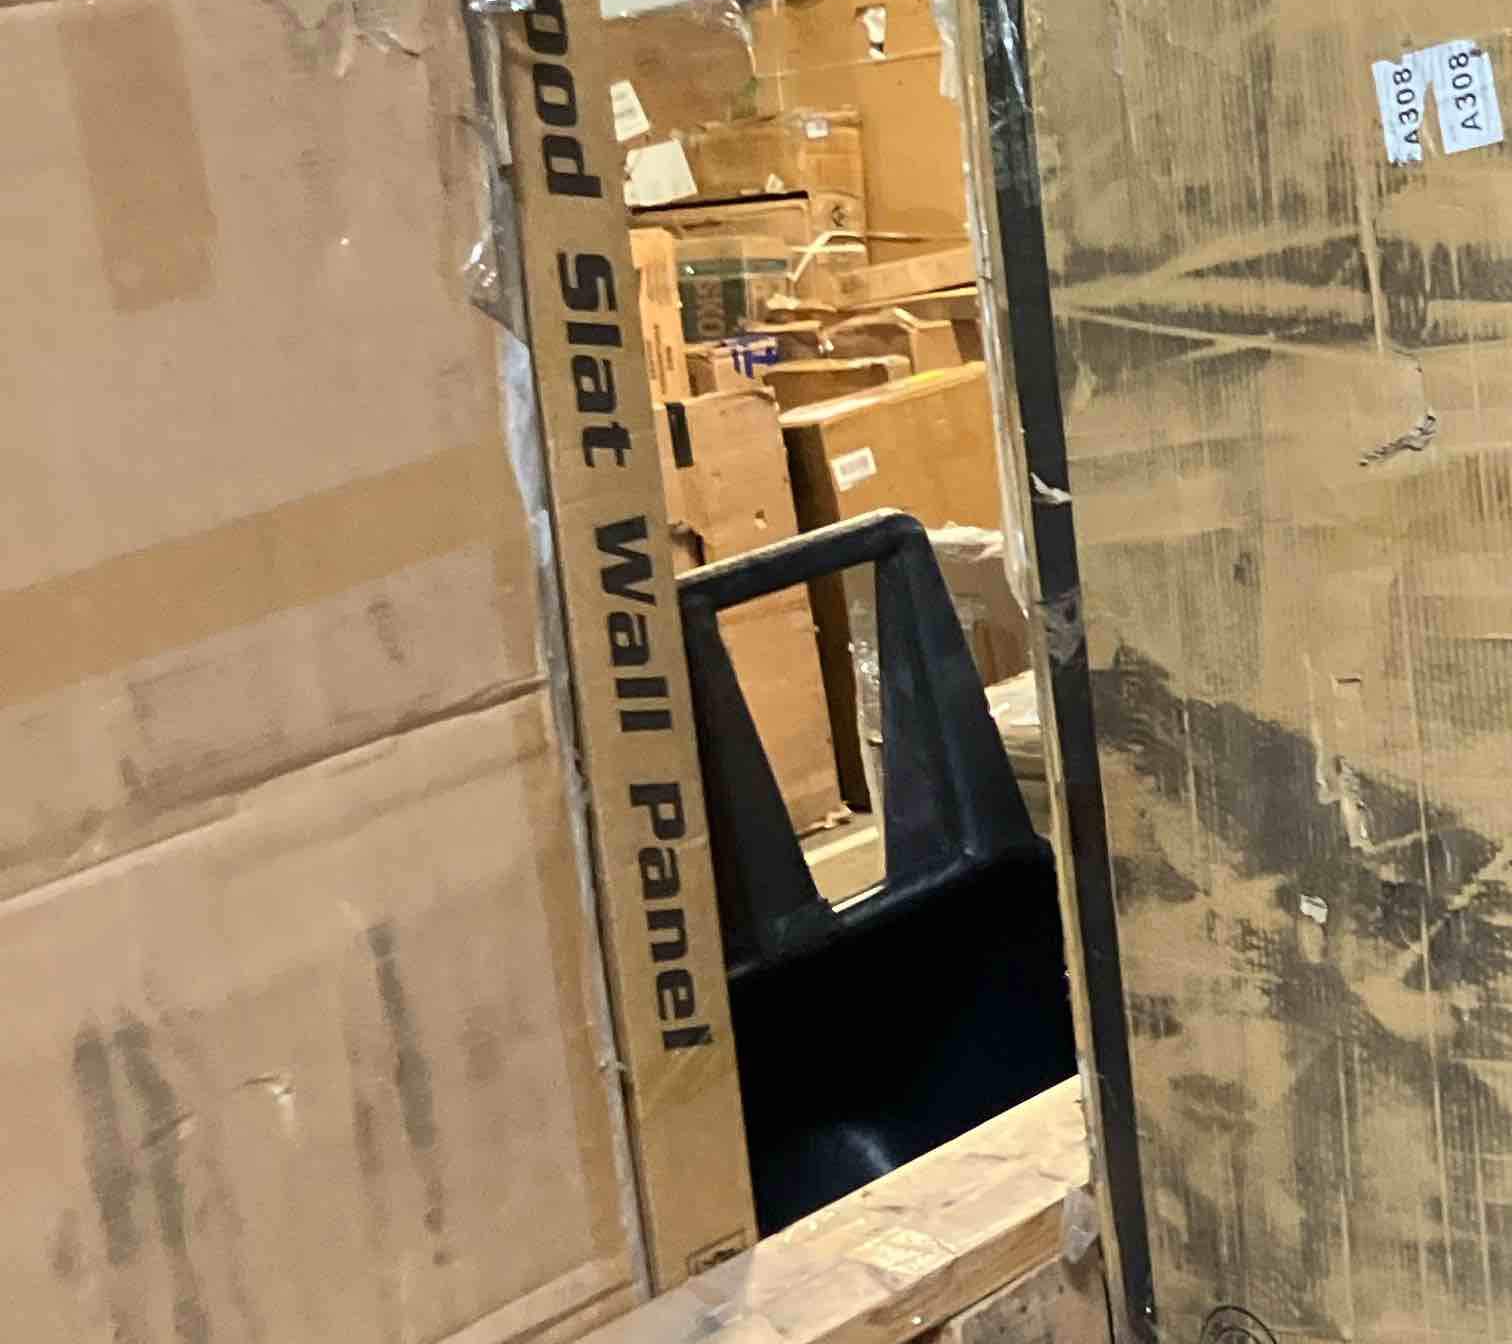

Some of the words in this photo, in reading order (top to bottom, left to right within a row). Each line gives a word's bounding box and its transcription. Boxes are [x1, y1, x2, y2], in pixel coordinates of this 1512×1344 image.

[1392, 67, 1420, 145] A308
[1447, 51, 1483, 132] A308
[557, 251, 633, 469] Slat
[594, 514, 674, 734] Wall
[628, 781, 715, 1052] Panel
